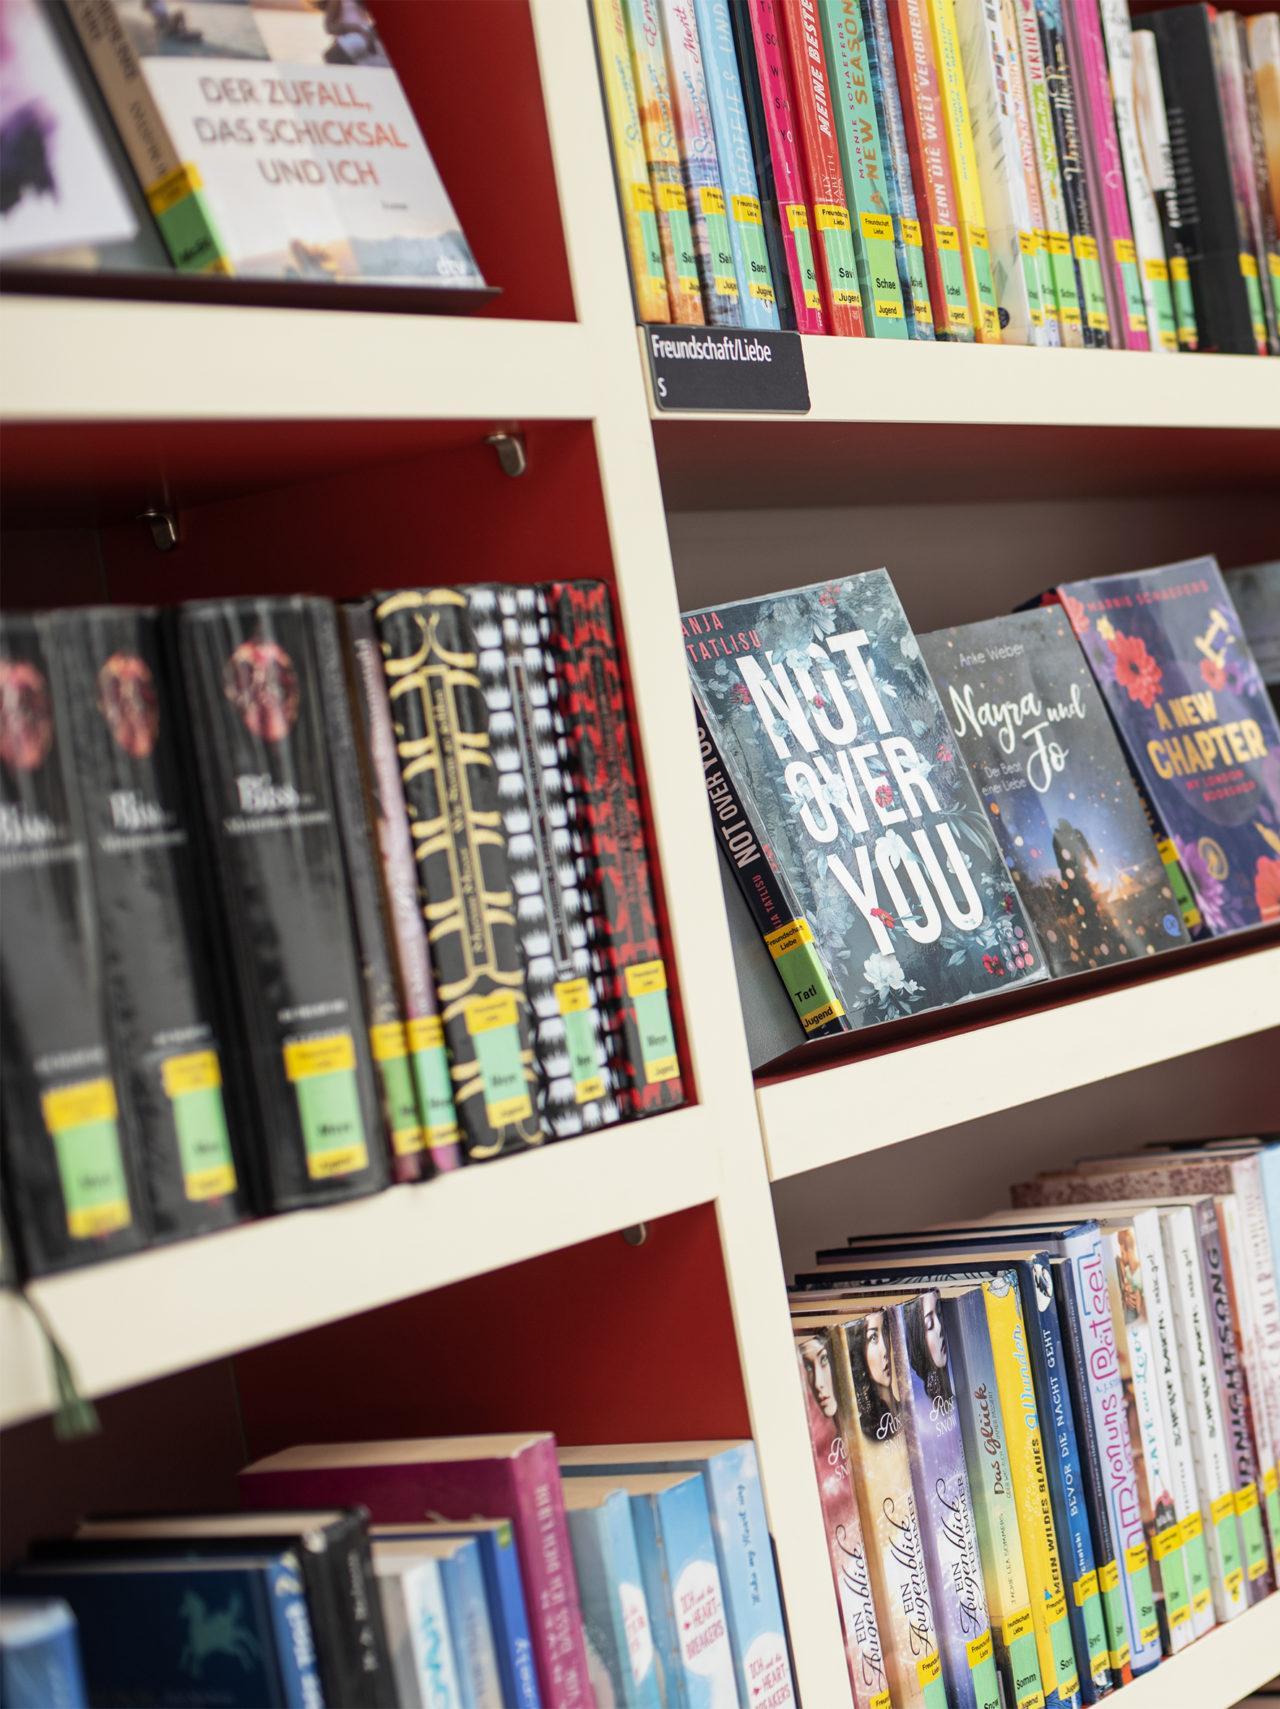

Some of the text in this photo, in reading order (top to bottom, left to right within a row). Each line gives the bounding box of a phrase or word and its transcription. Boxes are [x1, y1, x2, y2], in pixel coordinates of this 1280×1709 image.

[198, 76, 373, 112] DER ZUFALL,
[810, 69, 832, 138] MEINE
[837, 22, 865, 179] MARNIE SCHAEFERS
[843, 0, 884, 209] A NEW SEASON
[192, 117, 409, 149] DAS SCHICKSAL
[919, 94, 940, 141] WELT
[257, 158, 380, 187] UND ICH
[929, 146, 944, 178] DIE
[875, 277, 897, 291] Schae
[879, 304, 898, 316] Jugend
[651, 334, 772, 362] Freundschaft/Liebe
[657, 376, 668, 398] S
[686, 629, 762, 663] TATLISU
[959, 642, 1024, 669] Anke Weber
[736, 629, 891, 760] NOT
[1153, 690, 1217, 731] A NEW
[948, 682, 1086, 754] Nayra und
[1021, 720, 1069, 794] Jo
[1146, 718, 1269, 781] CHAPTER
[705, 771, 738, 821] OVER
[783, 736, 941, 844] OVER
[1001, 777, 1027, 792] Liebe
[721, 819, 761, 869] NOT
[751, 873, 777, 914] TATLISU
[827, 822, 985, 957] YOU
[780, 937, 798, 951] Liebe
[794, 984, 818, 1003] Tatl
[803, 1005, 834, 1029] Jugend
[974, 1382, 1005, 1495] Das Glück
[1043, 1329, 1079, 1518] BEVOR DIE NACHT GEHT
[1031, 1438, 1047, 1494] BLAUES
[958, 1475, 970, 1535] IMMER
[1041, 1498, 1055, 1553] WILDES
[883, 1497, 934, 1658] Augenblick
[935, 1478, 984, 1638] Augenblick
[951, 1562, 963, 1593] EIN
[1049, 1556, 1061, 1595] MEIN
[901, 1582, 914, 1616] EIN
[852, 1611, 865, 1645] EIN
[1016, 1673, 1037, 1690] Somm
